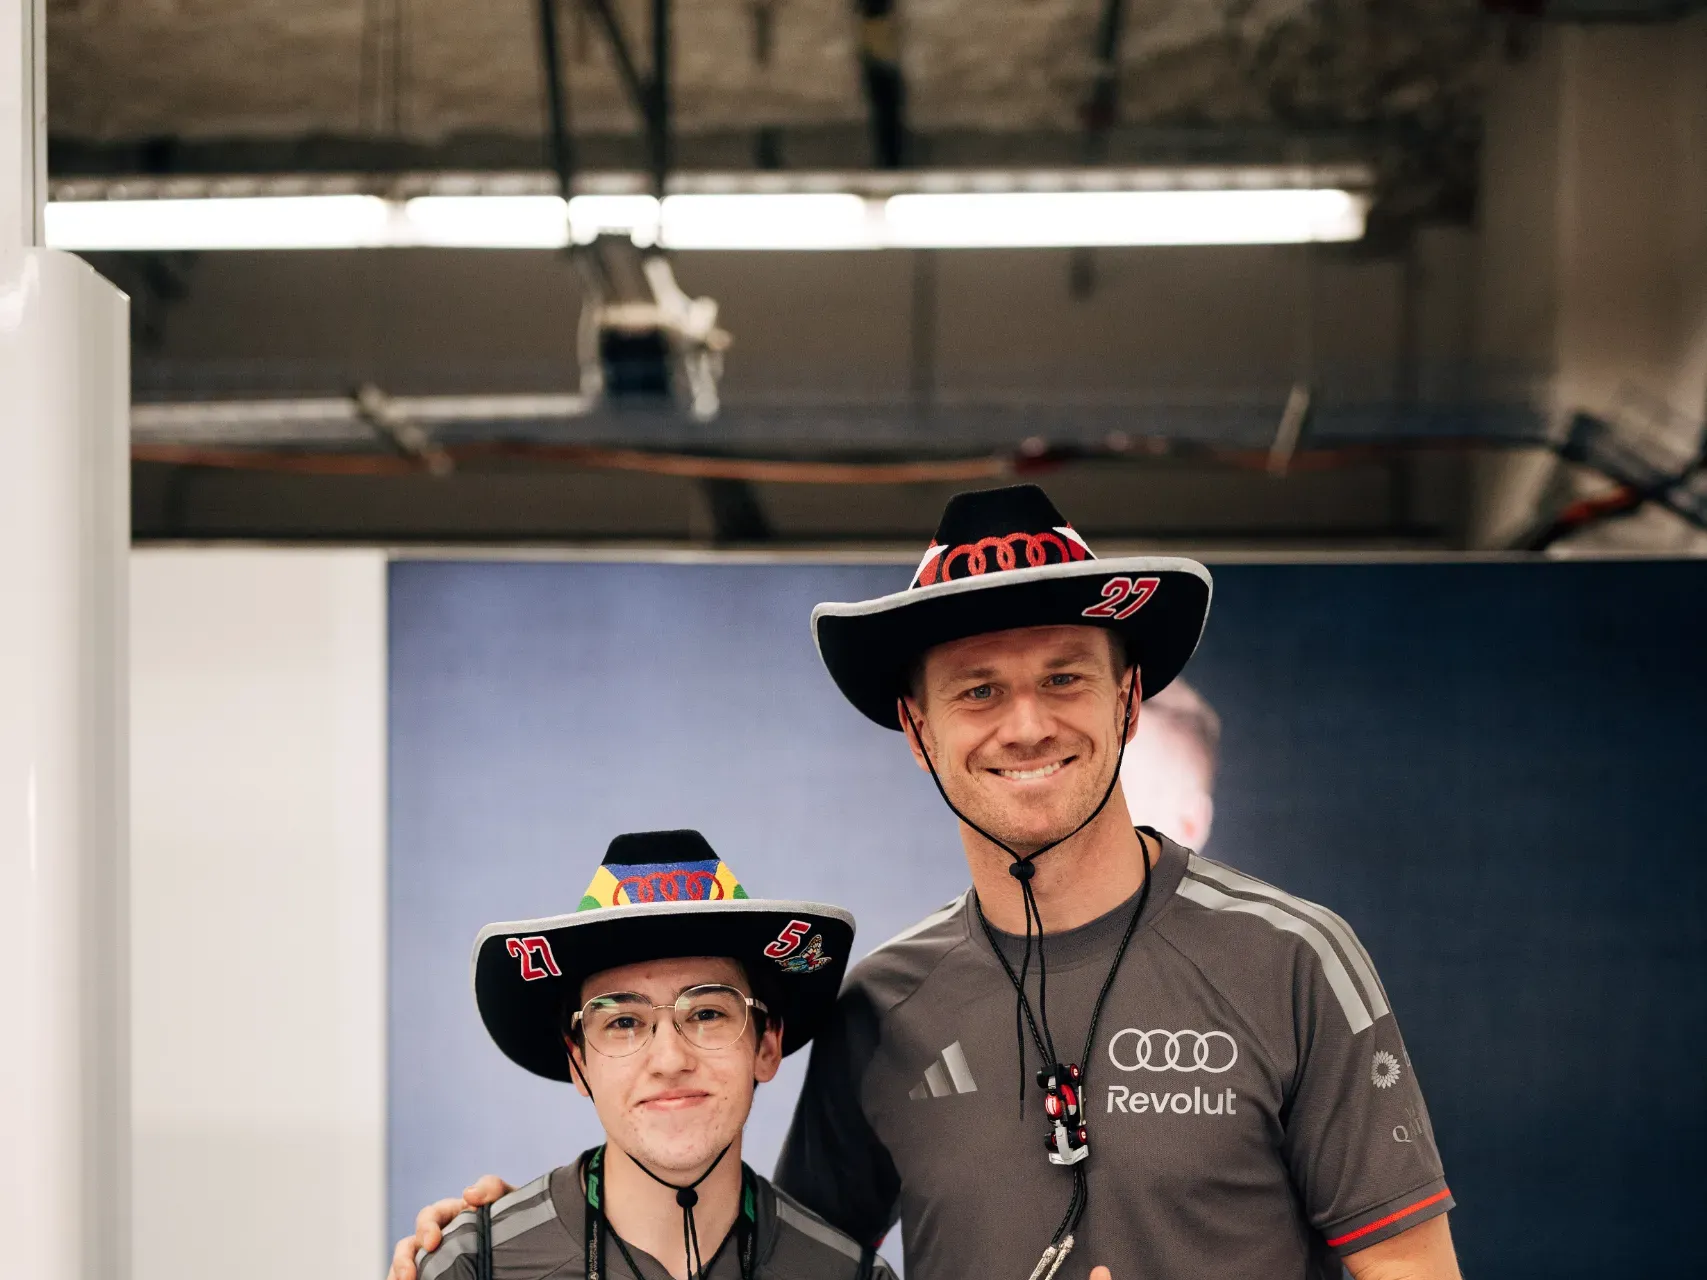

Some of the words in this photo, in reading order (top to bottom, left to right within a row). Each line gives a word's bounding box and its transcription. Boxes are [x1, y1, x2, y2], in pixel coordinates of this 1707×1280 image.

[1082, 576, 1161, 620] 27
[505, 935, 562, 981] 27
[763, 920, 812, 959] 5
[1106, 1085, 1237, 1115] Revolut
